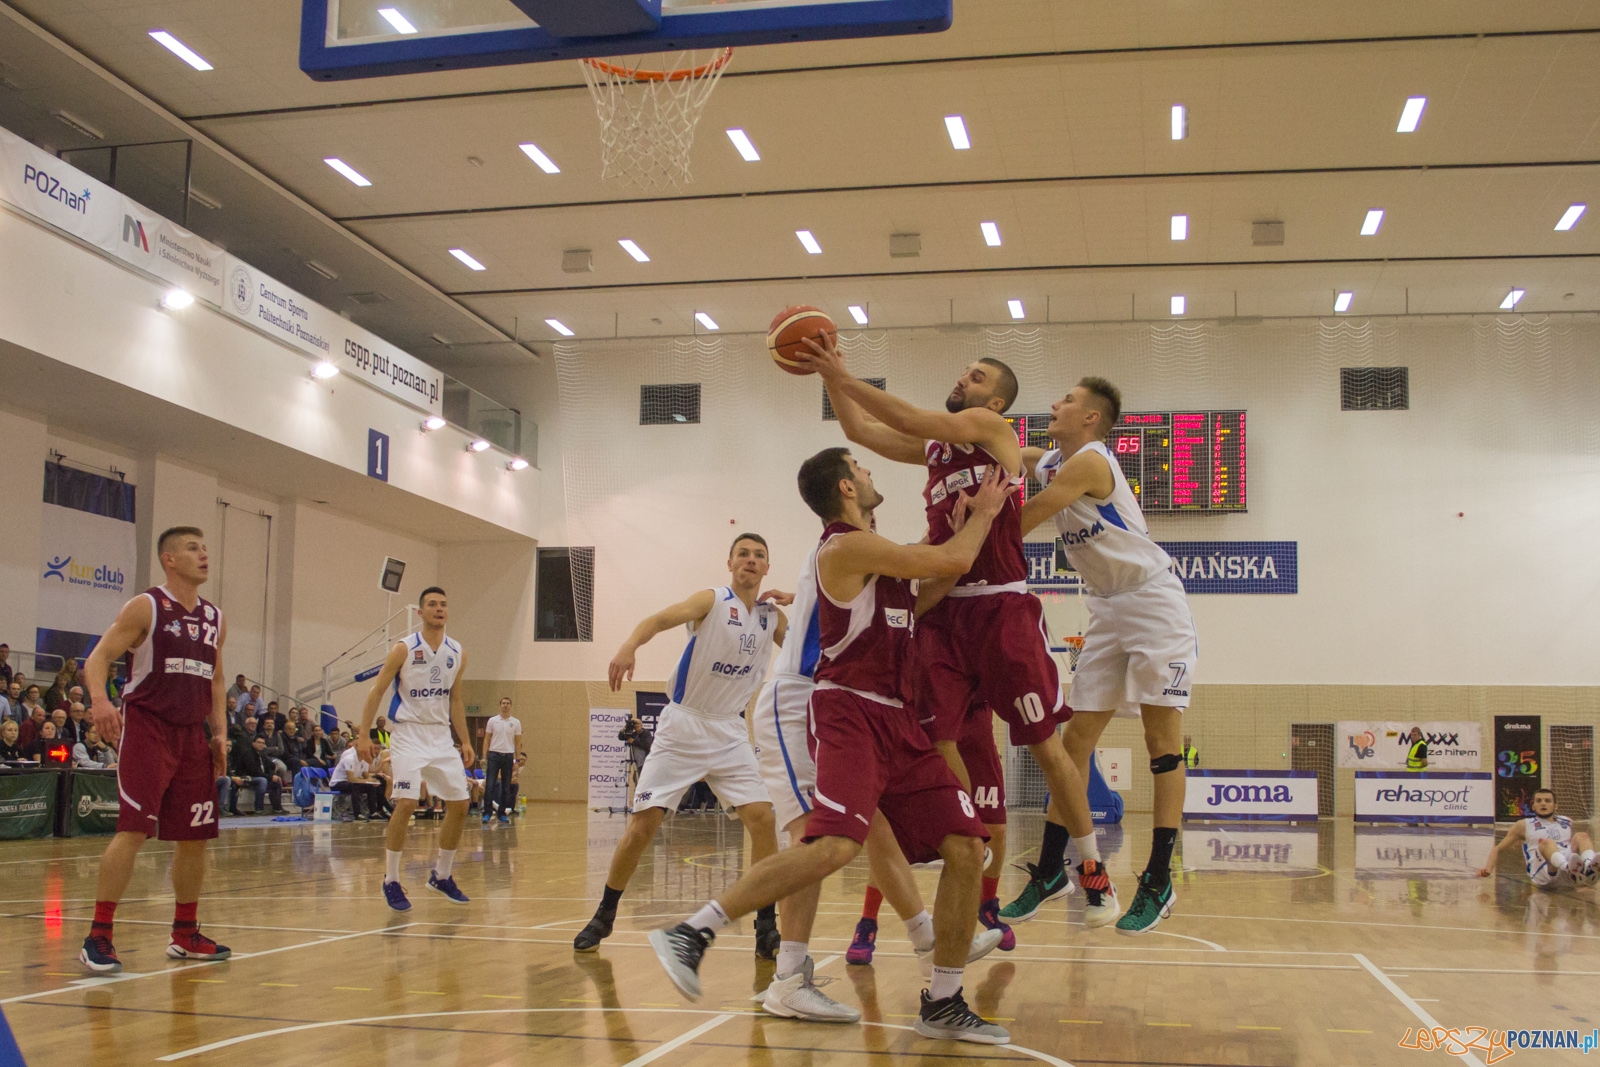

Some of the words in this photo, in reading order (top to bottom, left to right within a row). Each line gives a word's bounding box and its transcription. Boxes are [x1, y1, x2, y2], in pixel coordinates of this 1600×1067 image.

[159, 234, 195, 260] Ministerstwo
[195, 252, 212, 267] Nauki
[162, 250, 195, 274] Szkolnictwa
[259, 283, 287, 309] Centrum
[288, 302, 309, 321] Sportu
[258, 304, 295, 334] Politechniki
[296, 323, 330, 354] Poznańskiej
[344, 338, 439, 404] cspp.put.poznan.pl
[1117, 436, 1140, 454] 65
[1162, 438, 1169, 447] 3
[375, 437, 383, 475] 1
[1162, 463, 1169, 471] 4
[932, 487, 945, 501] PEC
[947, 475, 970, 490] MPGK
[1134, 485, 1140, 494] 5
[69, 559, 125, 585] funclub
[1171, 552, 1278, 579] NAŃSKA
[69, 576, 91, 586] biuro
[738, 633, 757, 656] 14
[430, 665, 442, 684] 2
[1168, 662, 1187, 688] 7
[1013, 692, 1046, 726] 10
[1503, 722, 1531, 730] drukma
[397, 781, 411, 790] PBG
[974, 785, 1000, 809] 44
[1375, 784, 1470, 807] rehasport
[190, 800, 215, 827] 22
[957, 790, 975, 819] 8
[1443, 803, 1468, 811] clinic
